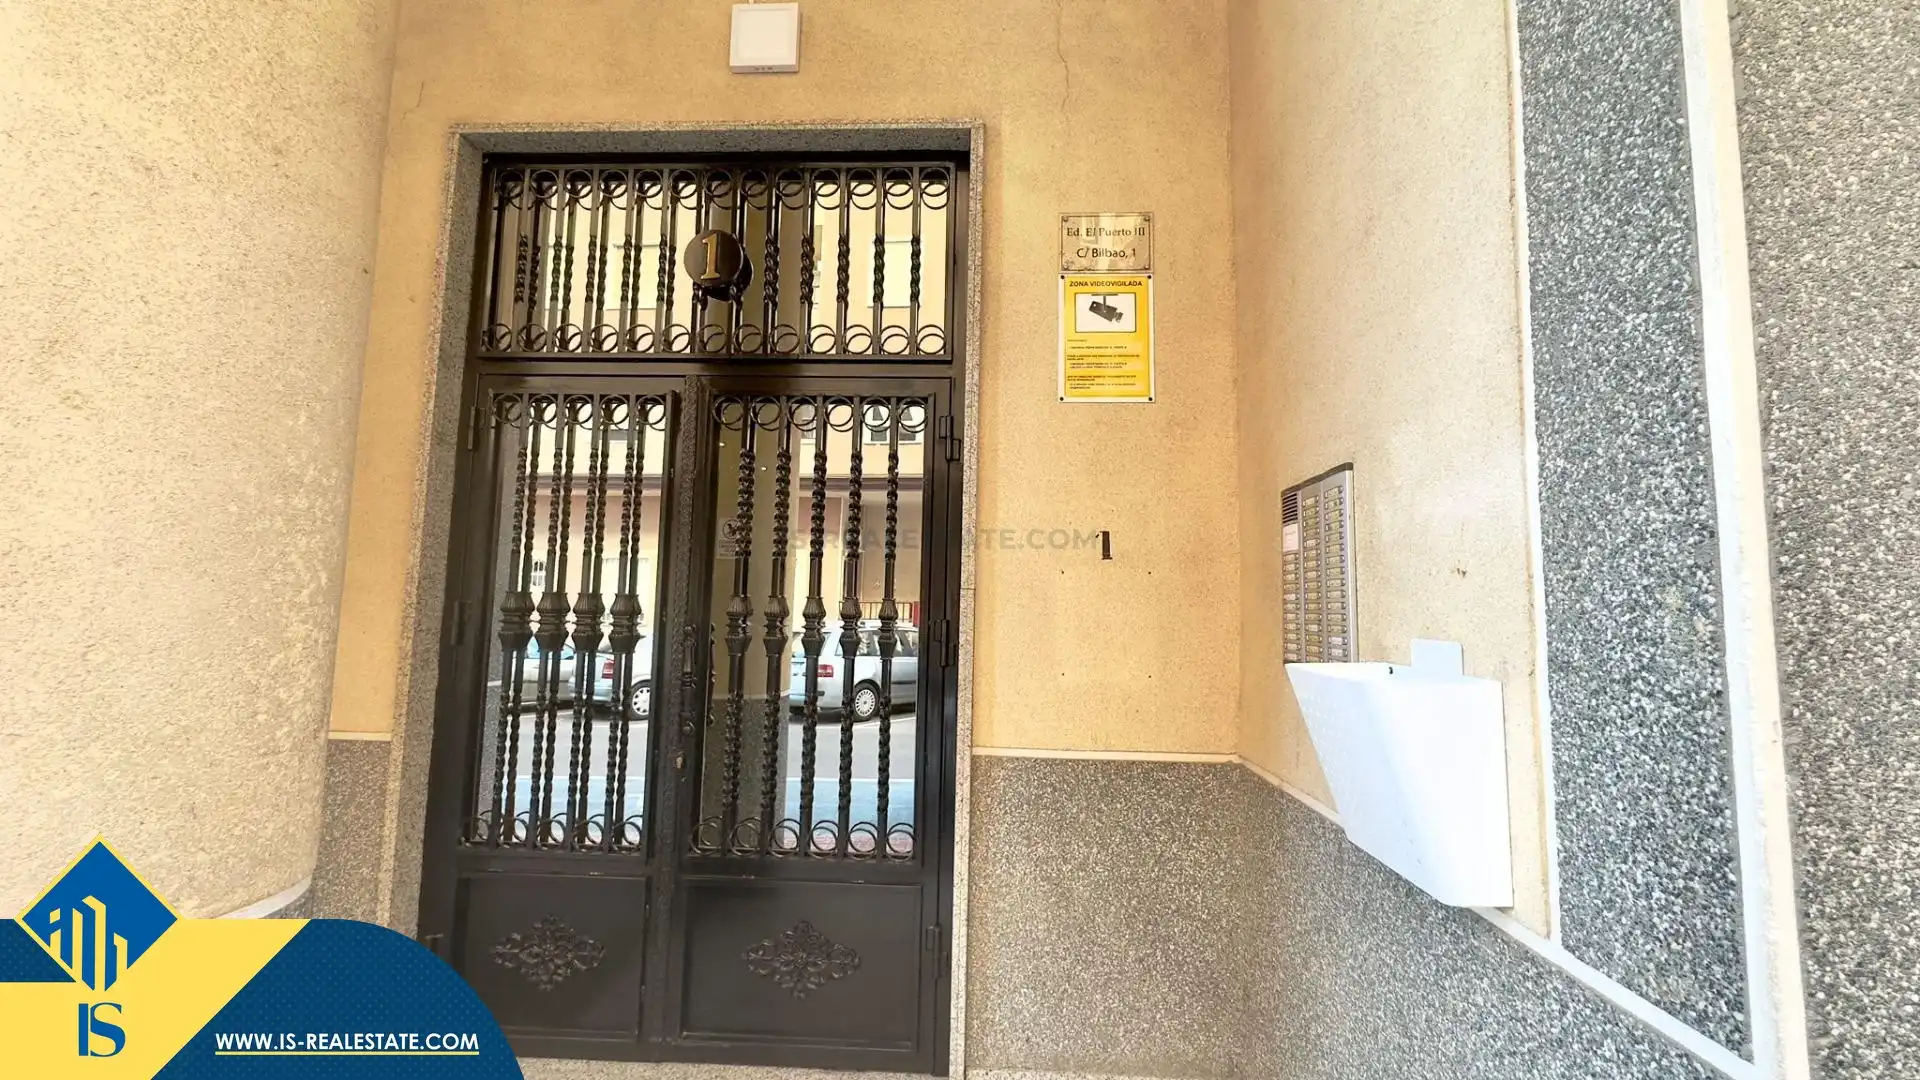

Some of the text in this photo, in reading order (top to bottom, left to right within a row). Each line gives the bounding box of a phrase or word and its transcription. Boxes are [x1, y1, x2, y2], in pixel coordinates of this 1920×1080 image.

[1066, 227, 1083, 237] Ed.
[1086, 227, 1096, 237] El
[1098, 227, 1132, 237] Puerto
[702, 233, 720, 279] 1
[1076, 247, 1090, 258] C/
[1091, 247, 1128, 259] Bilbao,
[1096, 530, 1113, 560] 1
